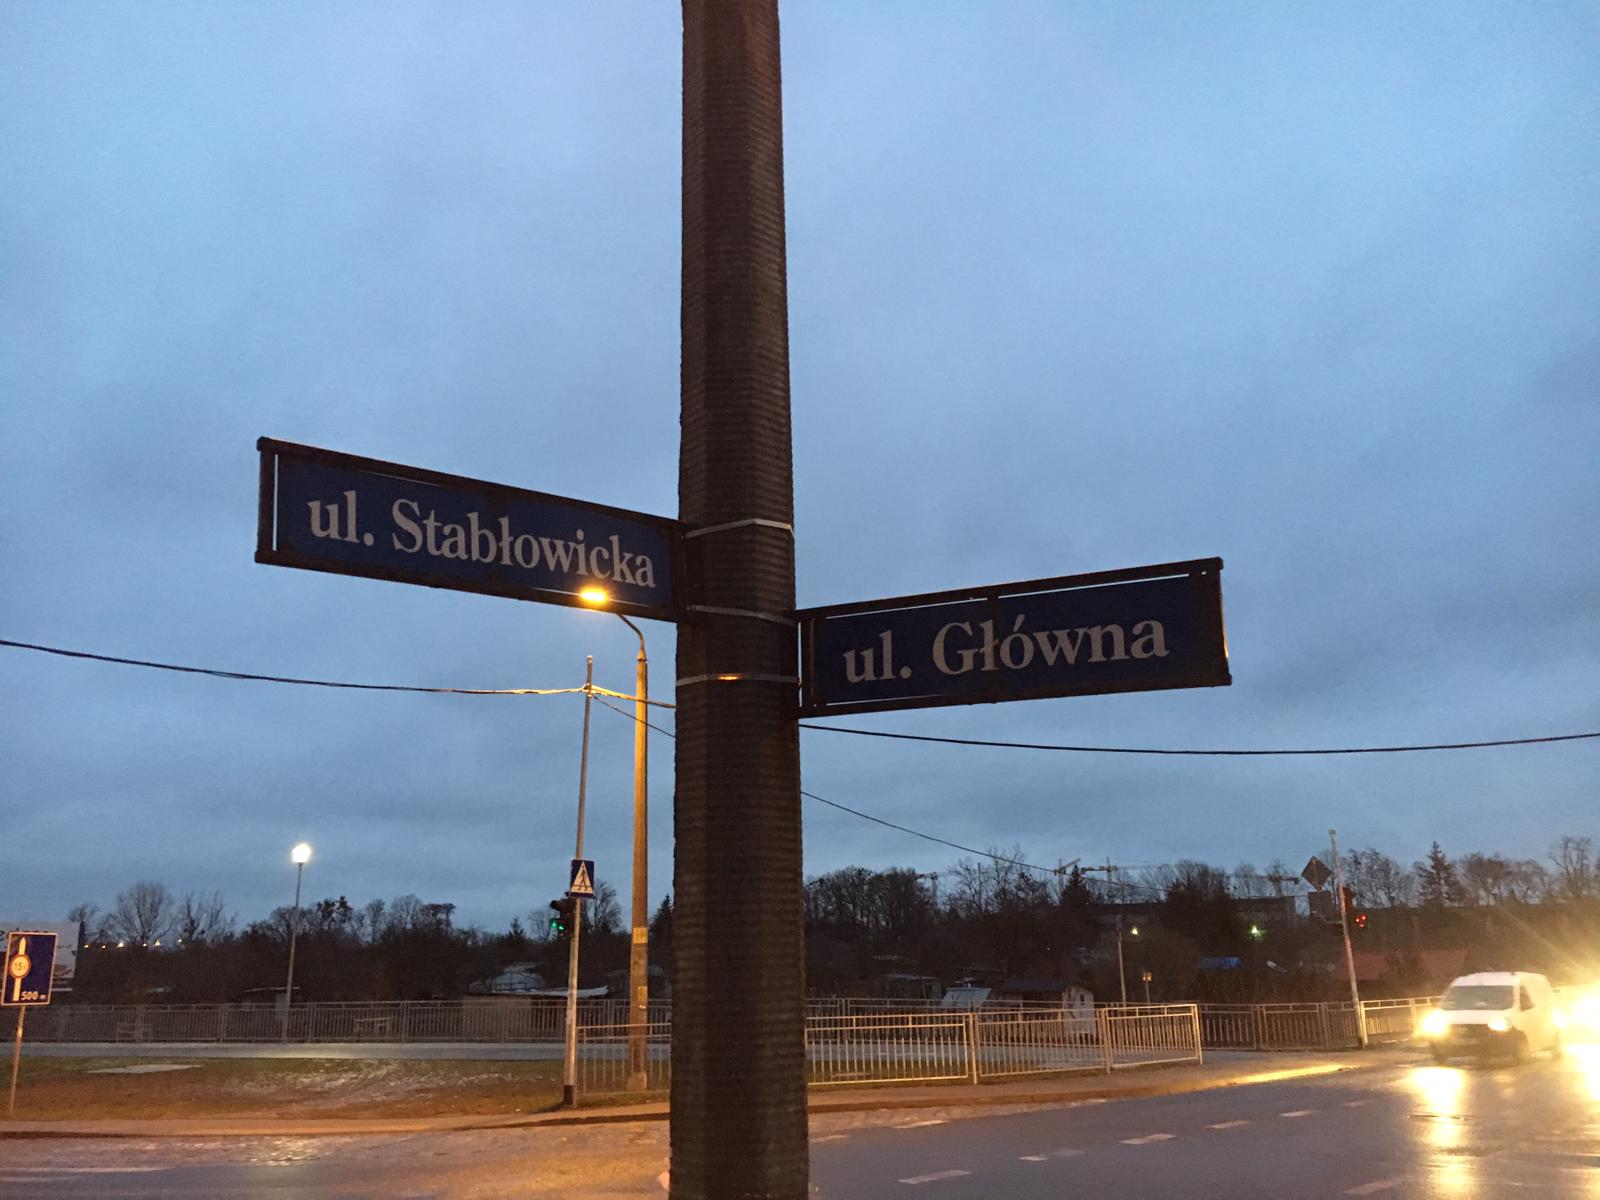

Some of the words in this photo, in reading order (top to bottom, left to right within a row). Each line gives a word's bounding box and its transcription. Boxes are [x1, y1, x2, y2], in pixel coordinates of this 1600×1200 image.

[307, 490, 374, 546] ul.
[391, 499, 656, 588] Stabłowicka
[842, 630, 912, 684] ul.
[932, 614, 1169, 676] Główna
[21, 990, 39, 1000] 500
